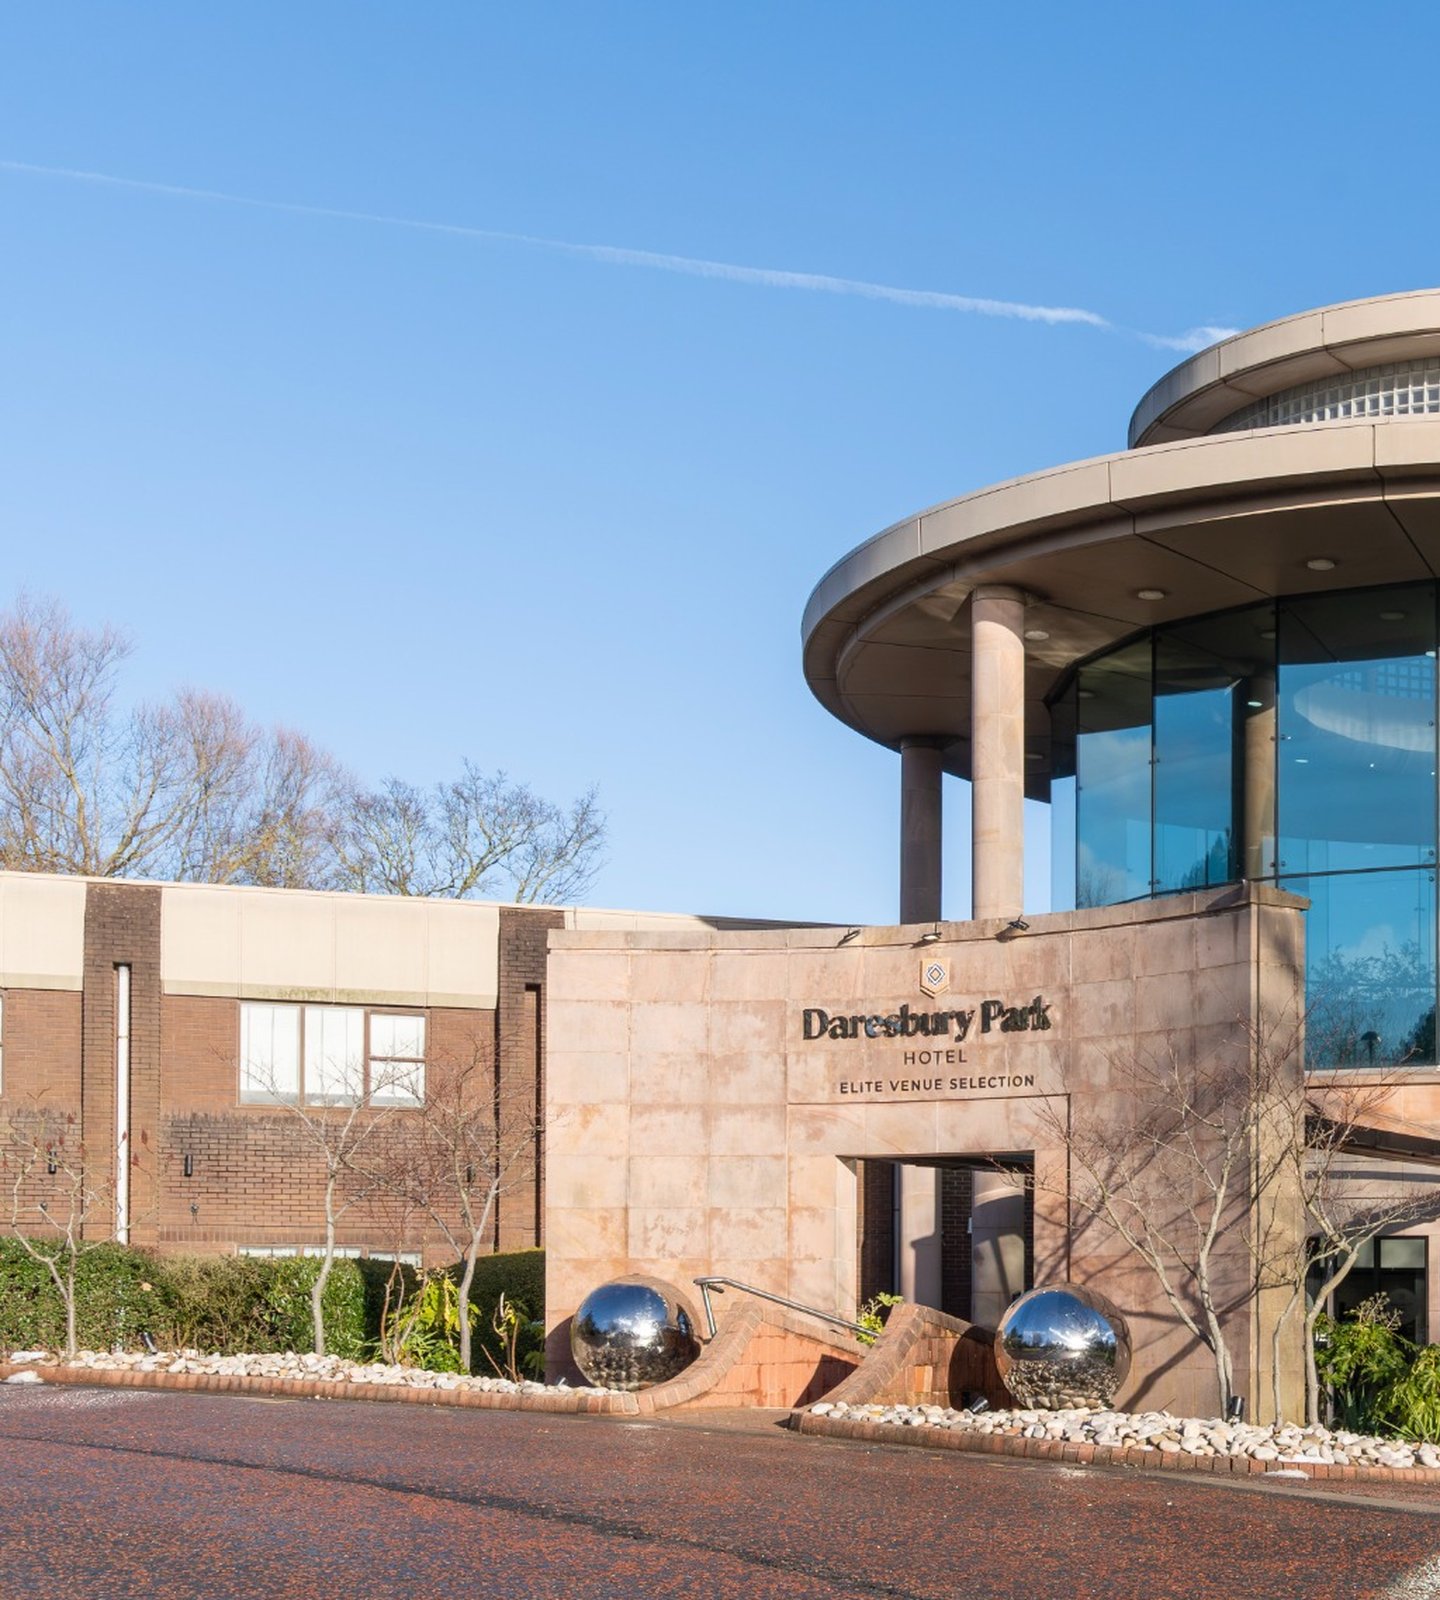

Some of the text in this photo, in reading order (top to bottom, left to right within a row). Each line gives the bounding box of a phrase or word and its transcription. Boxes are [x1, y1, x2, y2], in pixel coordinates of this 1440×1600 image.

[802, 994, 1052, 1042] Daresbury Park
[903, 1049, 968, 1066] HOTEL
[839, 1075, 1035, 1094] ELITE VENUE SELECTION
